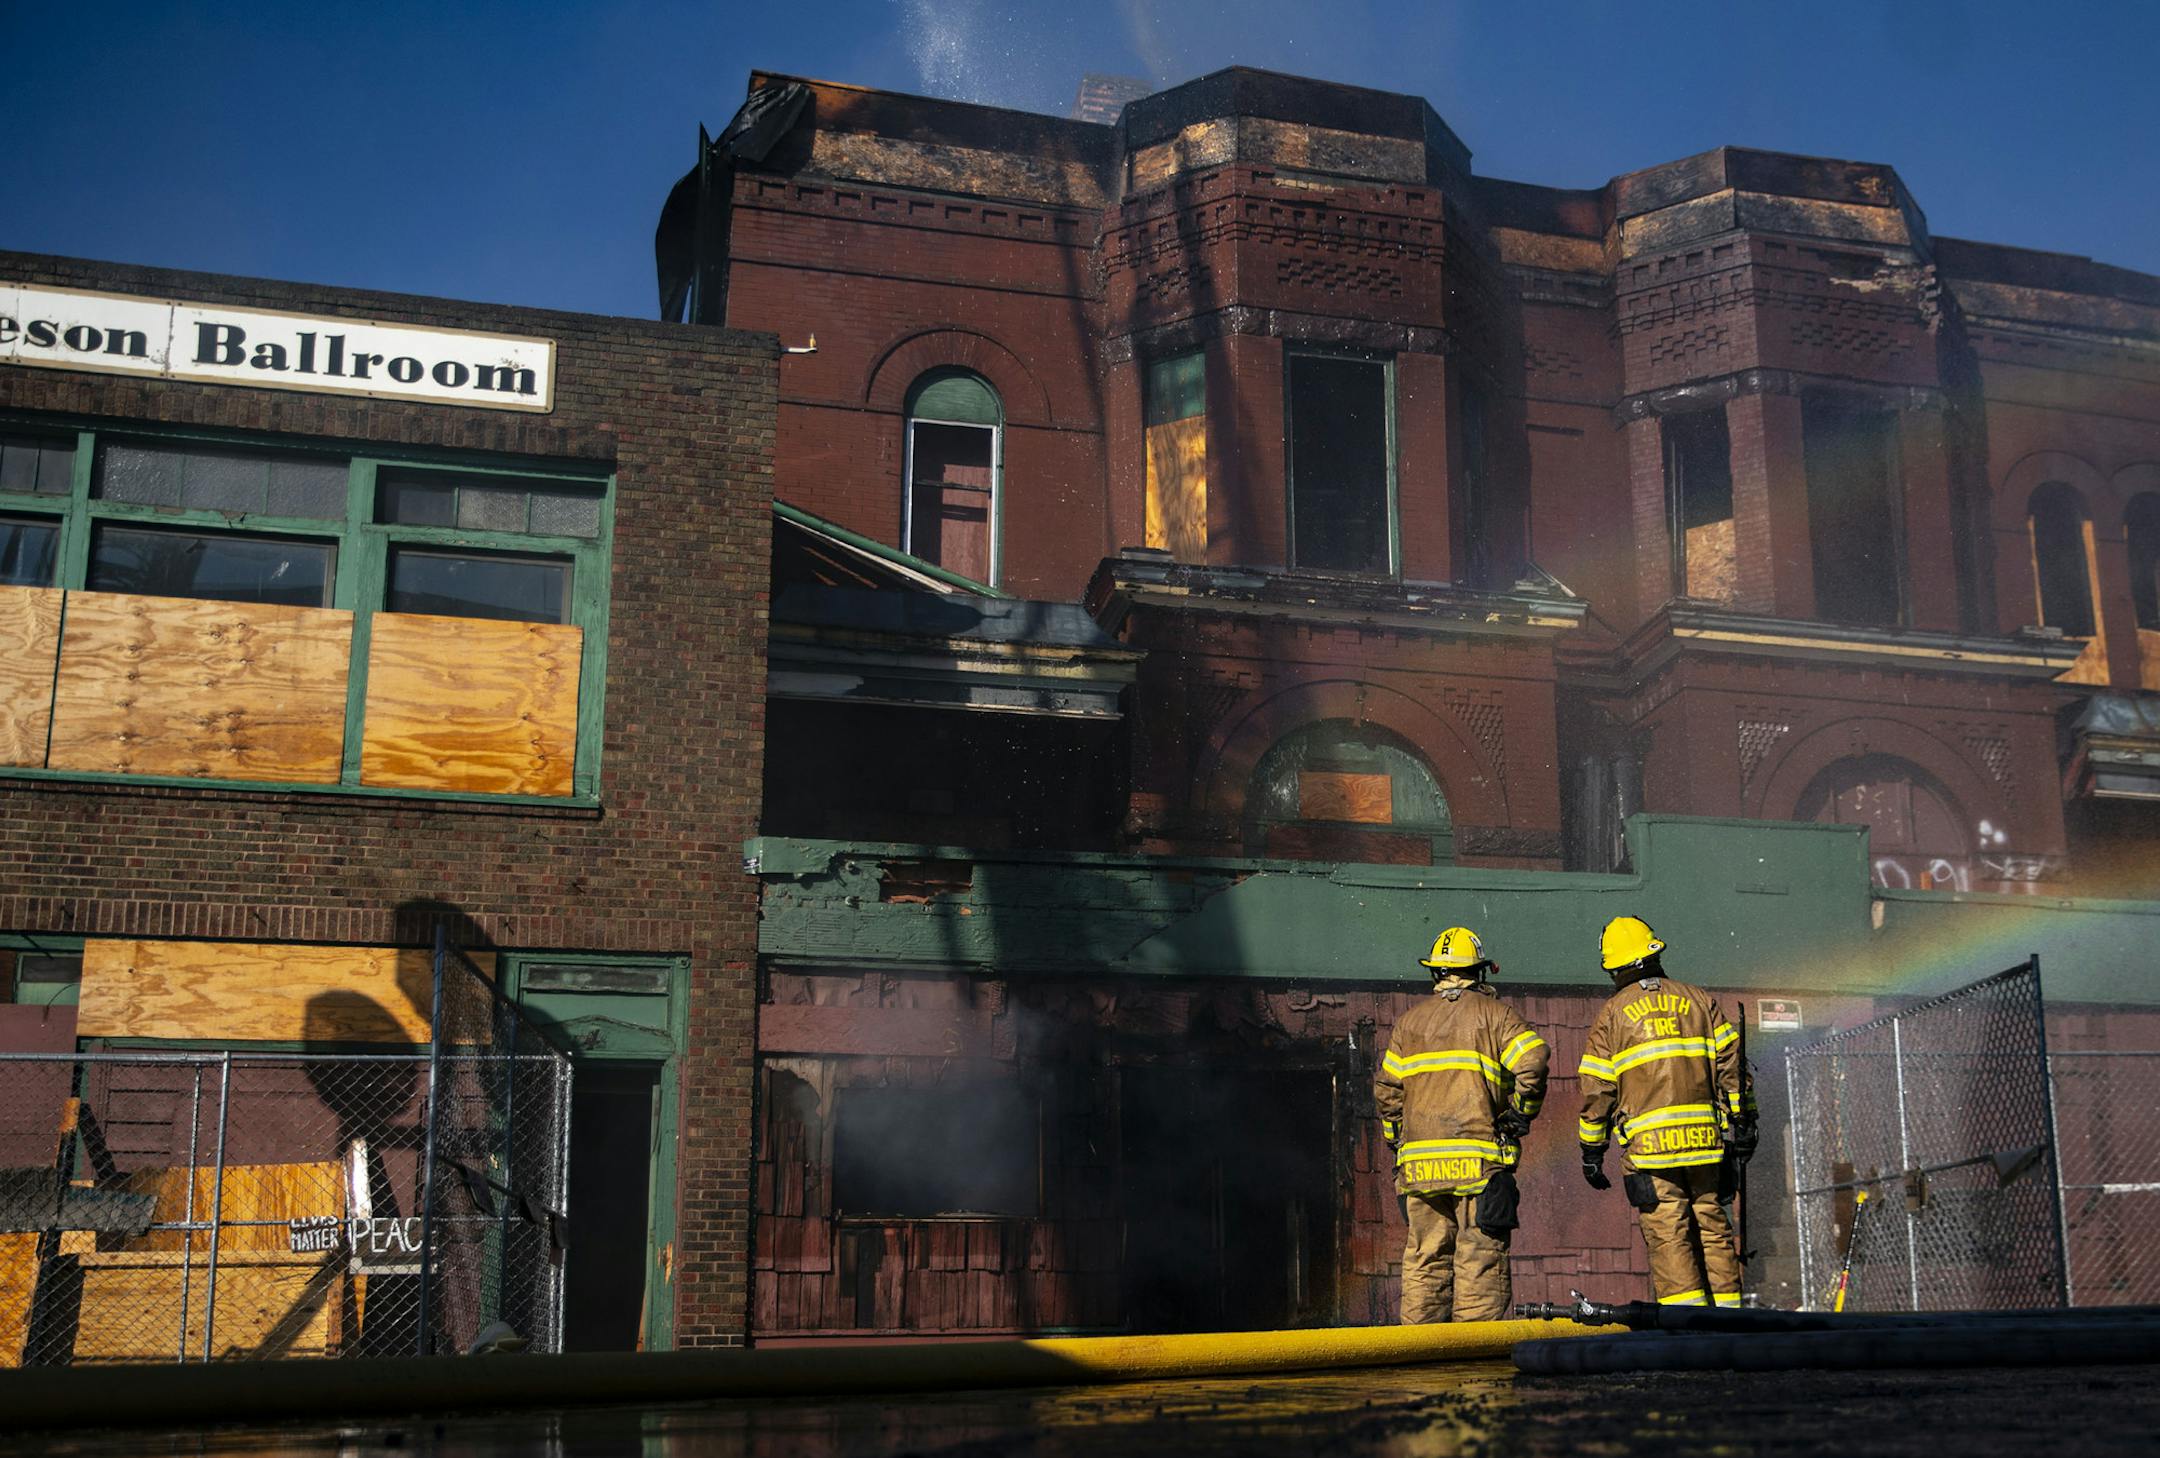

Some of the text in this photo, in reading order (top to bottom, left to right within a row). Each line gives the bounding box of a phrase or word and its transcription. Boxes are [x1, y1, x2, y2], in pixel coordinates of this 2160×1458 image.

[0, 316, 538, 396] eson Ballroom
[1622, 994, 1691, 1023] DULUTH
[1643, 1017, 1681, 1038] FIRE
[1658, 1126, 1716, 1151] HOUSER
[291, 1228, 340, 1251] MATTER
[351, 1217, 437, 1254] PEAC
